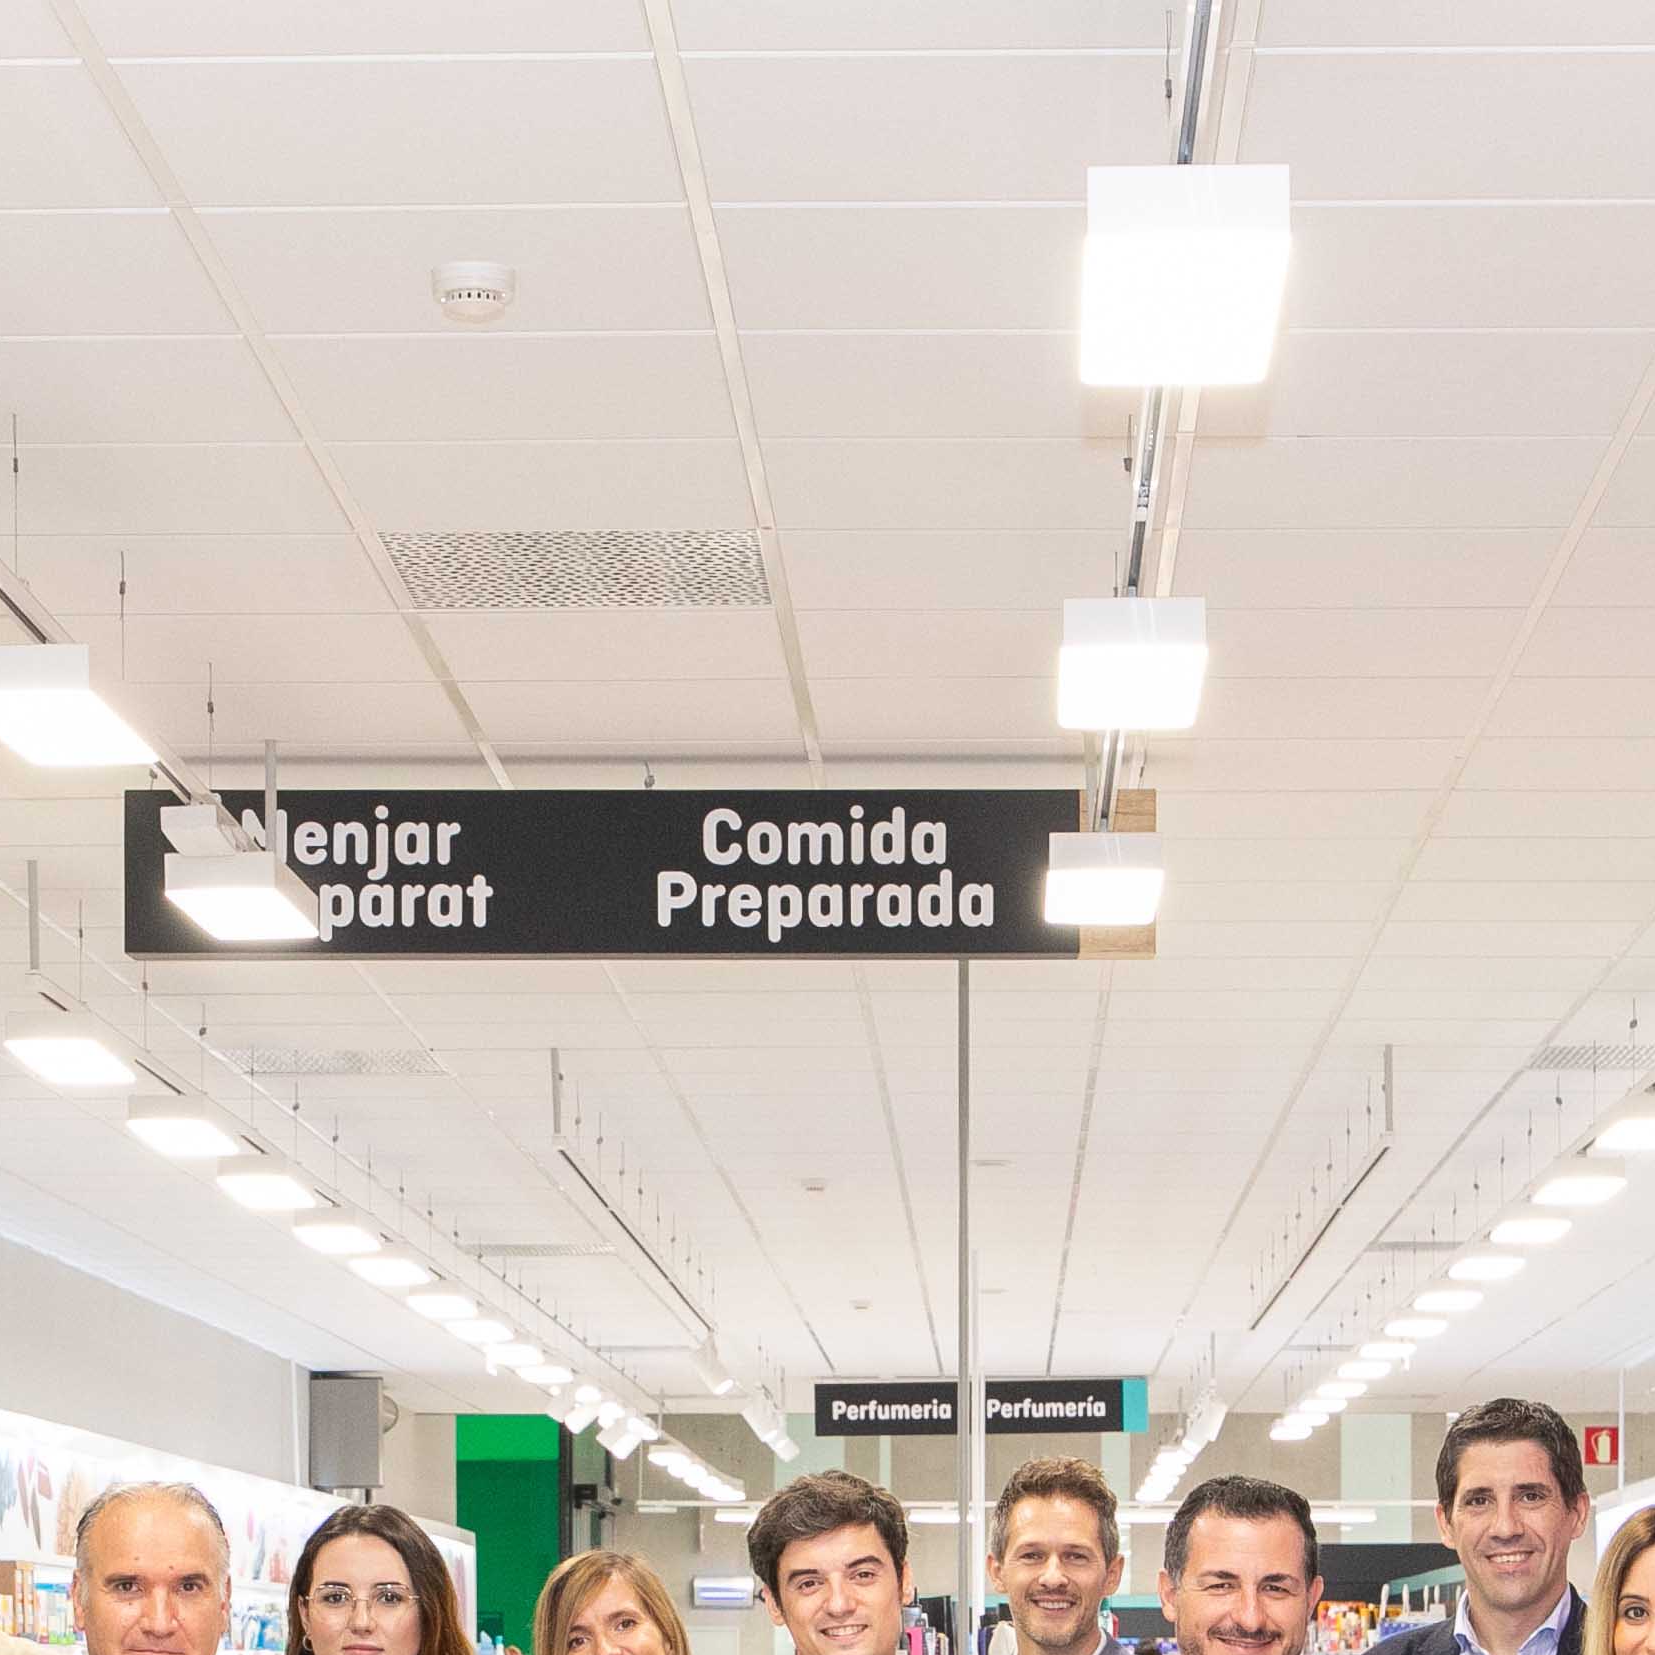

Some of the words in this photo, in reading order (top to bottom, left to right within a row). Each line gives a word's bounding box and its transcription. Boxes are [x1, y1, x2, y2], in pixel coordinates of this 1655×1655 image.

[702, 805, 946, 865] Comida
[657, 869, 994, 944] Preparada
[832, 1398, 952, 1421] Perfumeria
[986, 1396, 1106, 1419] Perfumería
